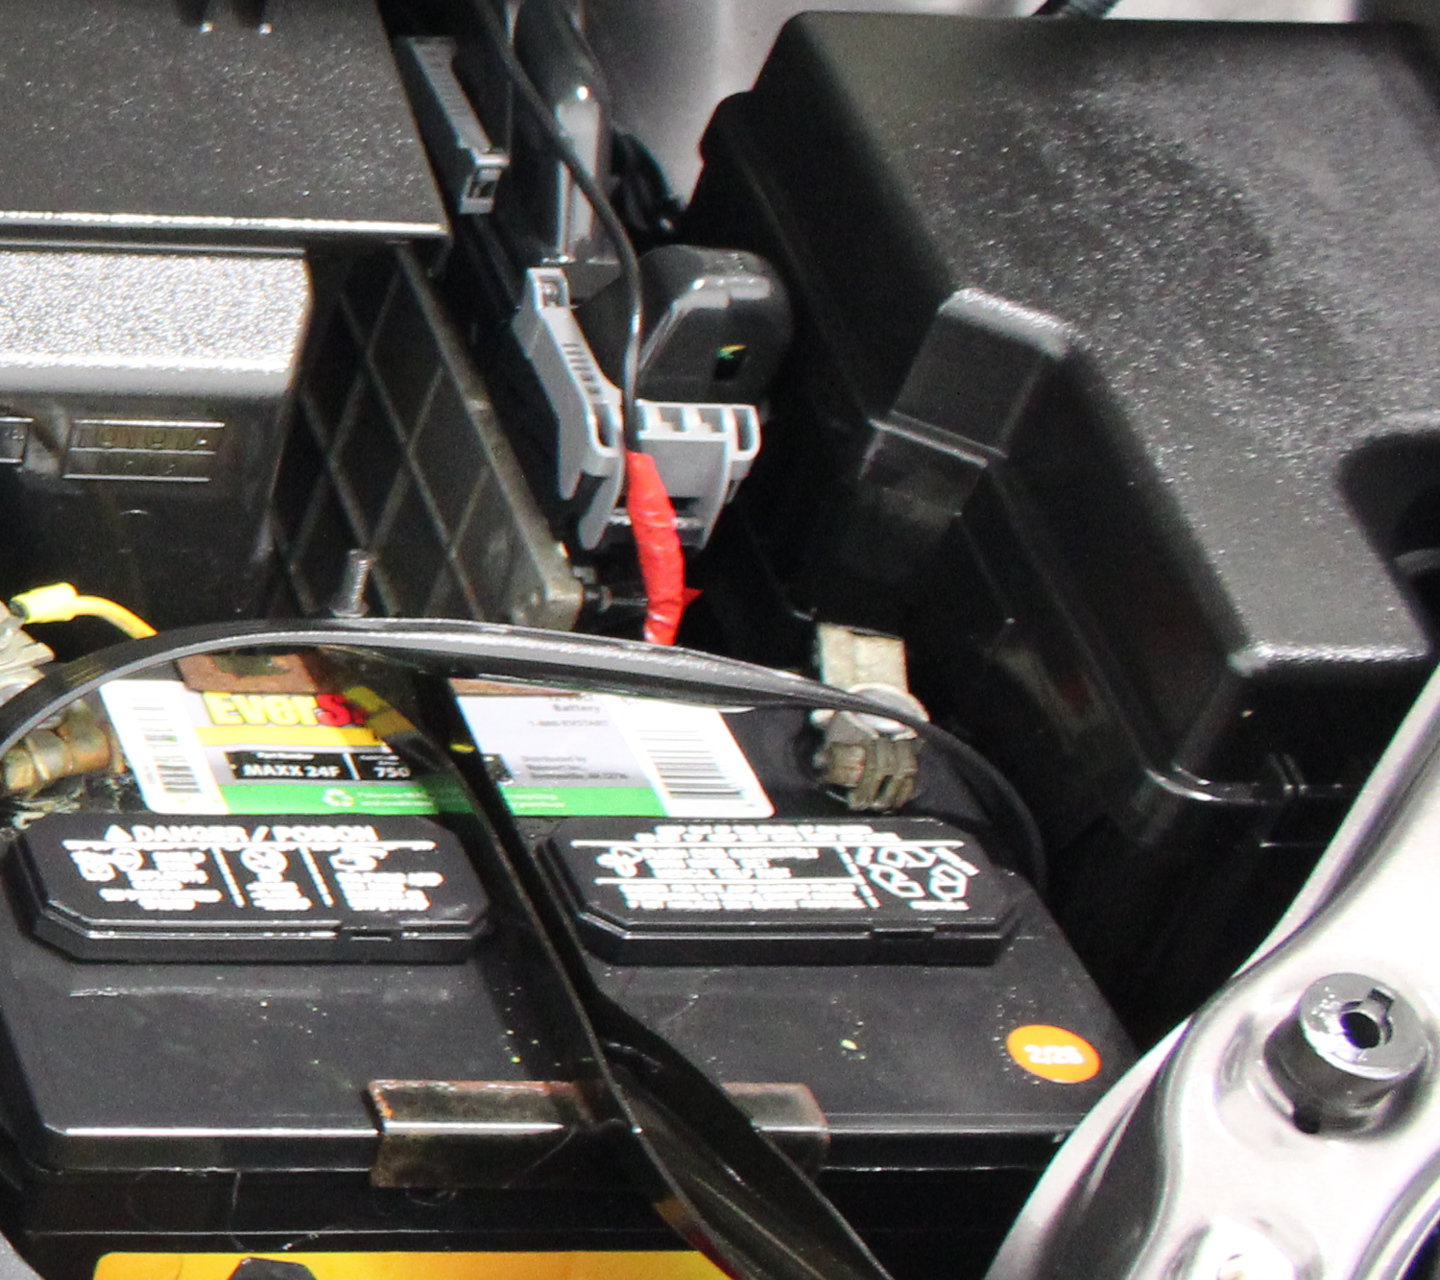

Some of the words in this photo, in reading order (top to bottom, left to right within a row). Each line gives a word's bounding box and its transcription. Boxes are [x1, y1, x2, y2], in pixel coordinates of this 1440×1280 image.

[243, 764, 304, 778] MAXX
[306, 765, 341, 778] 24F
[373, 766, 410, 778] 750
[132, 825, 248, 842] DANGER
[271, 825, 378, 842] POISON
